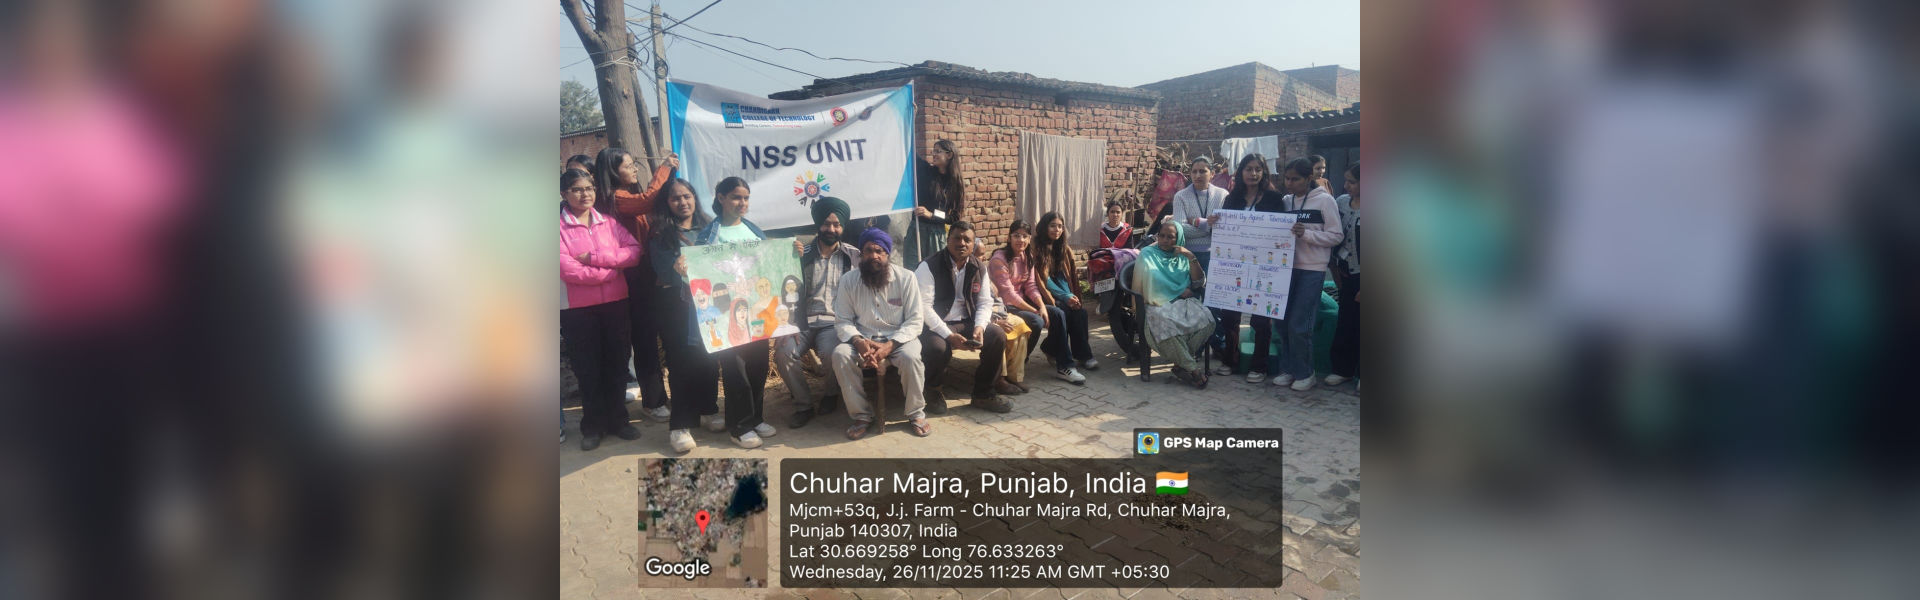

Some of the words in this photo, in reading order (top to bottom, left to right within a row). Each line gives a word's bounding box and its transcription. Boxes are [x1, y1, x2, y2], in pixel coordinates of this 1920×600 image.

[742, 114, 768, 122] COLLEGE
[740, 145, 798, 170] NSS
[806, 138, 867, 164] UNIT
